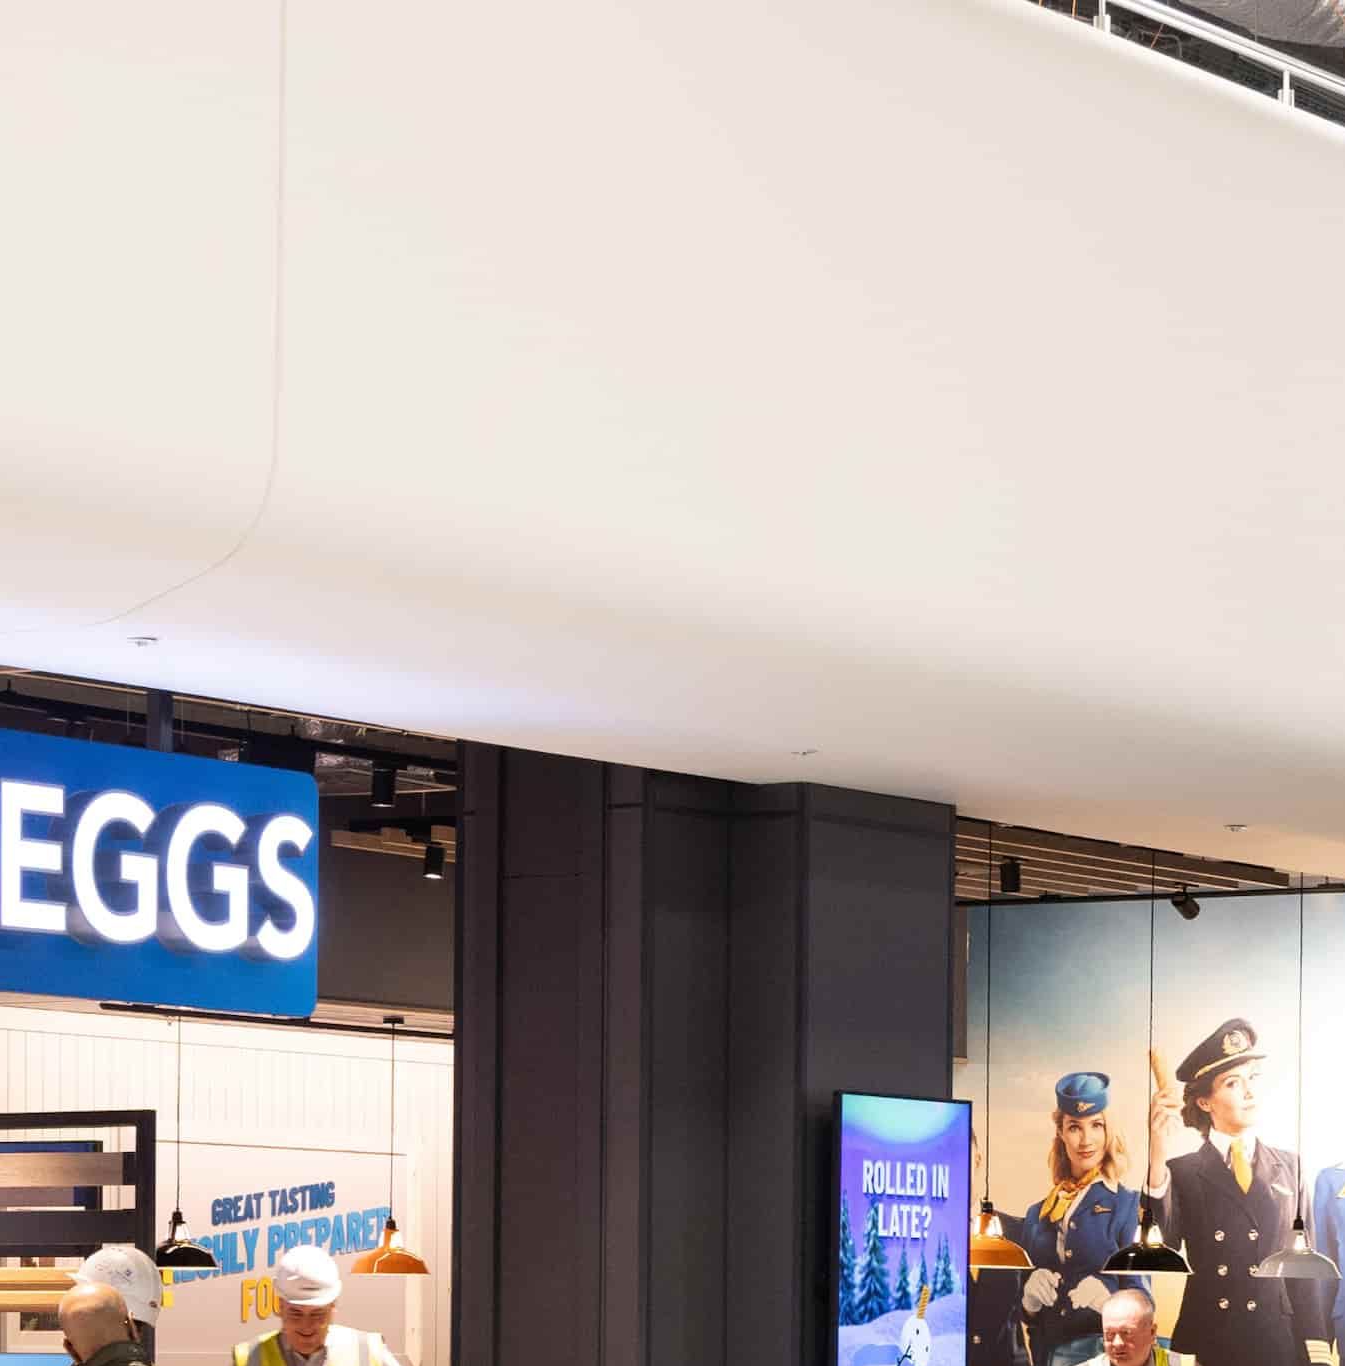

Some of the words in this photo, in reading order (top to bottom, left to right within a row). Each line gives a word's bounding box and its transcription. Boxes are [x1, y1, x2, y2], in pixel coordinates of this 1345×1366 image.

[862, 1159, 928, 1197] ROLLED
[931, 1165, 950, 1200] IN
[211, 1191, 264, 1226] GREAT
[268, 1181, 336, 1216] TASTING
[877, 1203, 933, 1239] LATE?
